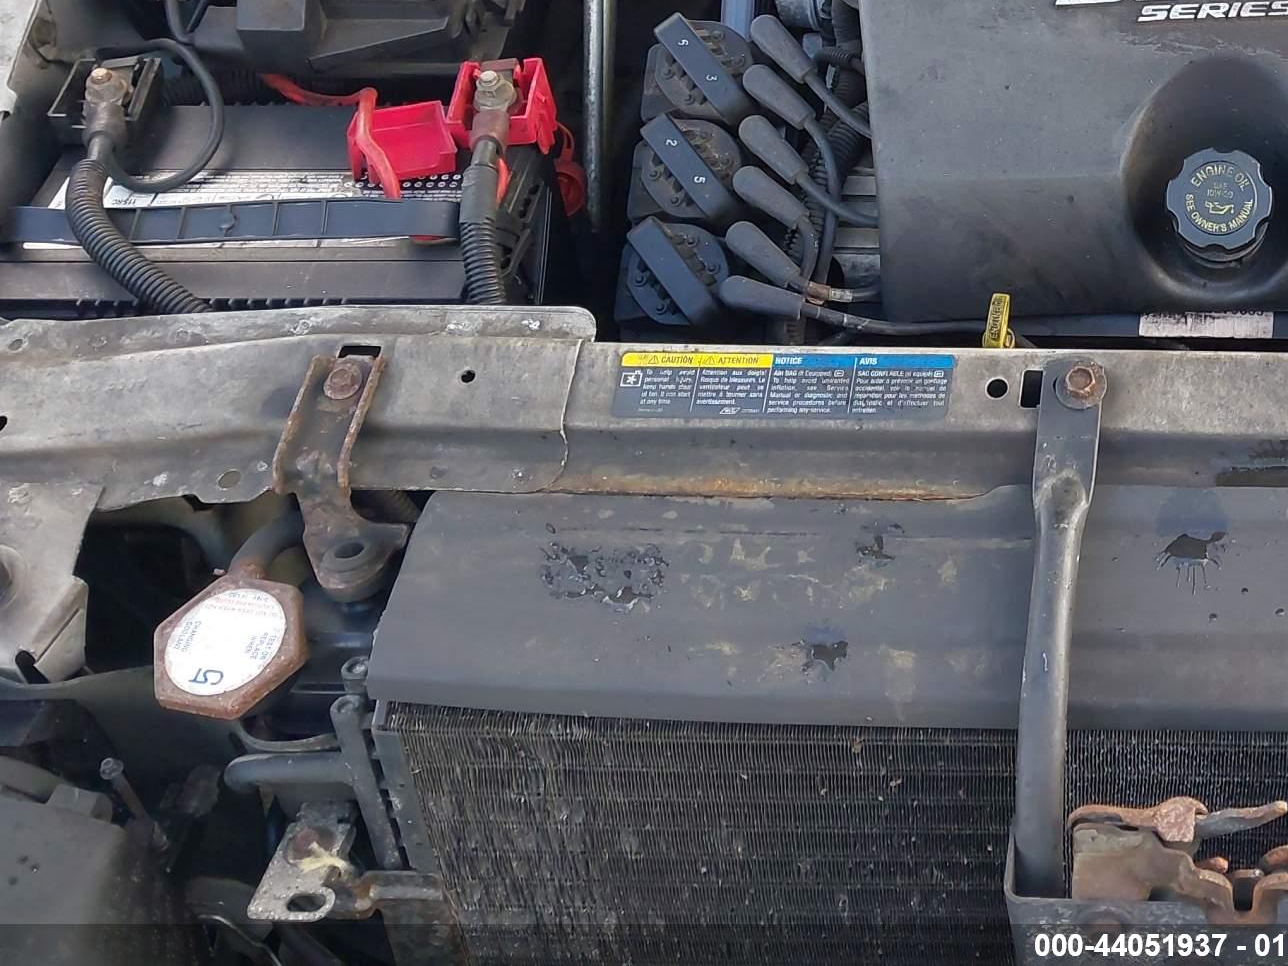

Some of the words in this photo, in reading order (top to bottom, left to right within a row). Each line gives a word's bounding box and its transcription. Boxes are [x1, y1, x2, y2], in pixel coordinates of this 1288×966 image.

[666, 139, 678, 147] 2
[694, 176, 706, 184] 5
[1191, 164, 1234, 187] ENGINE
[1235, 172, 1250, 192] OIL
[1185, 194, 1196, 212] SEE
[1191, 212, 1227, 232] OWNER'S
[1229, 199, 1254, 230] MANUAL
